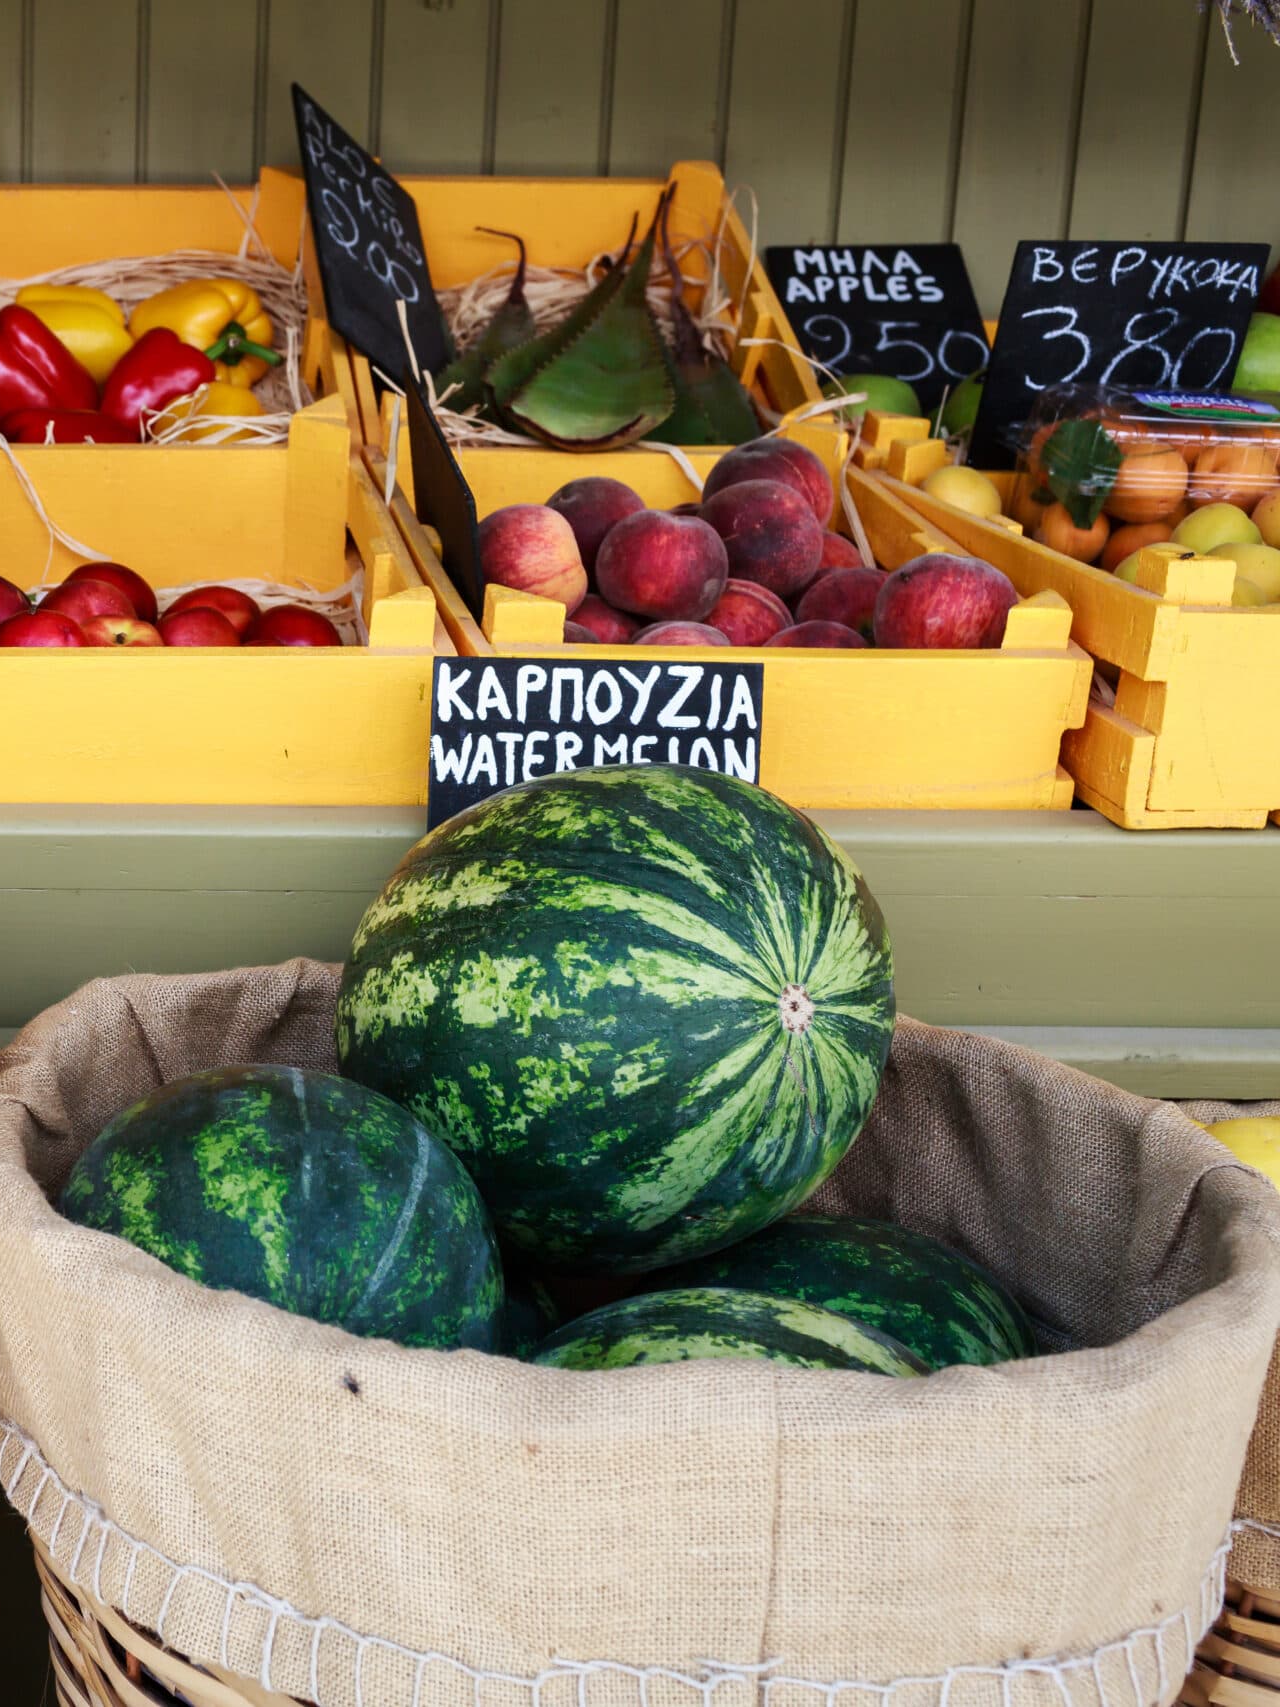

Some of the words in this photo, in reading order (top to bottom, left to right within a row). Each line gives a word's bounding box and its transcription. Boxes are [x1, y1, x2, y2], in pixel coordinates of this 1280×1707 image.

[793, 249, 923, 275] ΜΗΛΑ
[1031, 246, 1260, 302] ΒΕΡΥΚΟΚΑ
[786, 275, 945, 303] APPLES
[436, 662, 758, 732] ΚΑΡΠΟΥΖΙΑ
